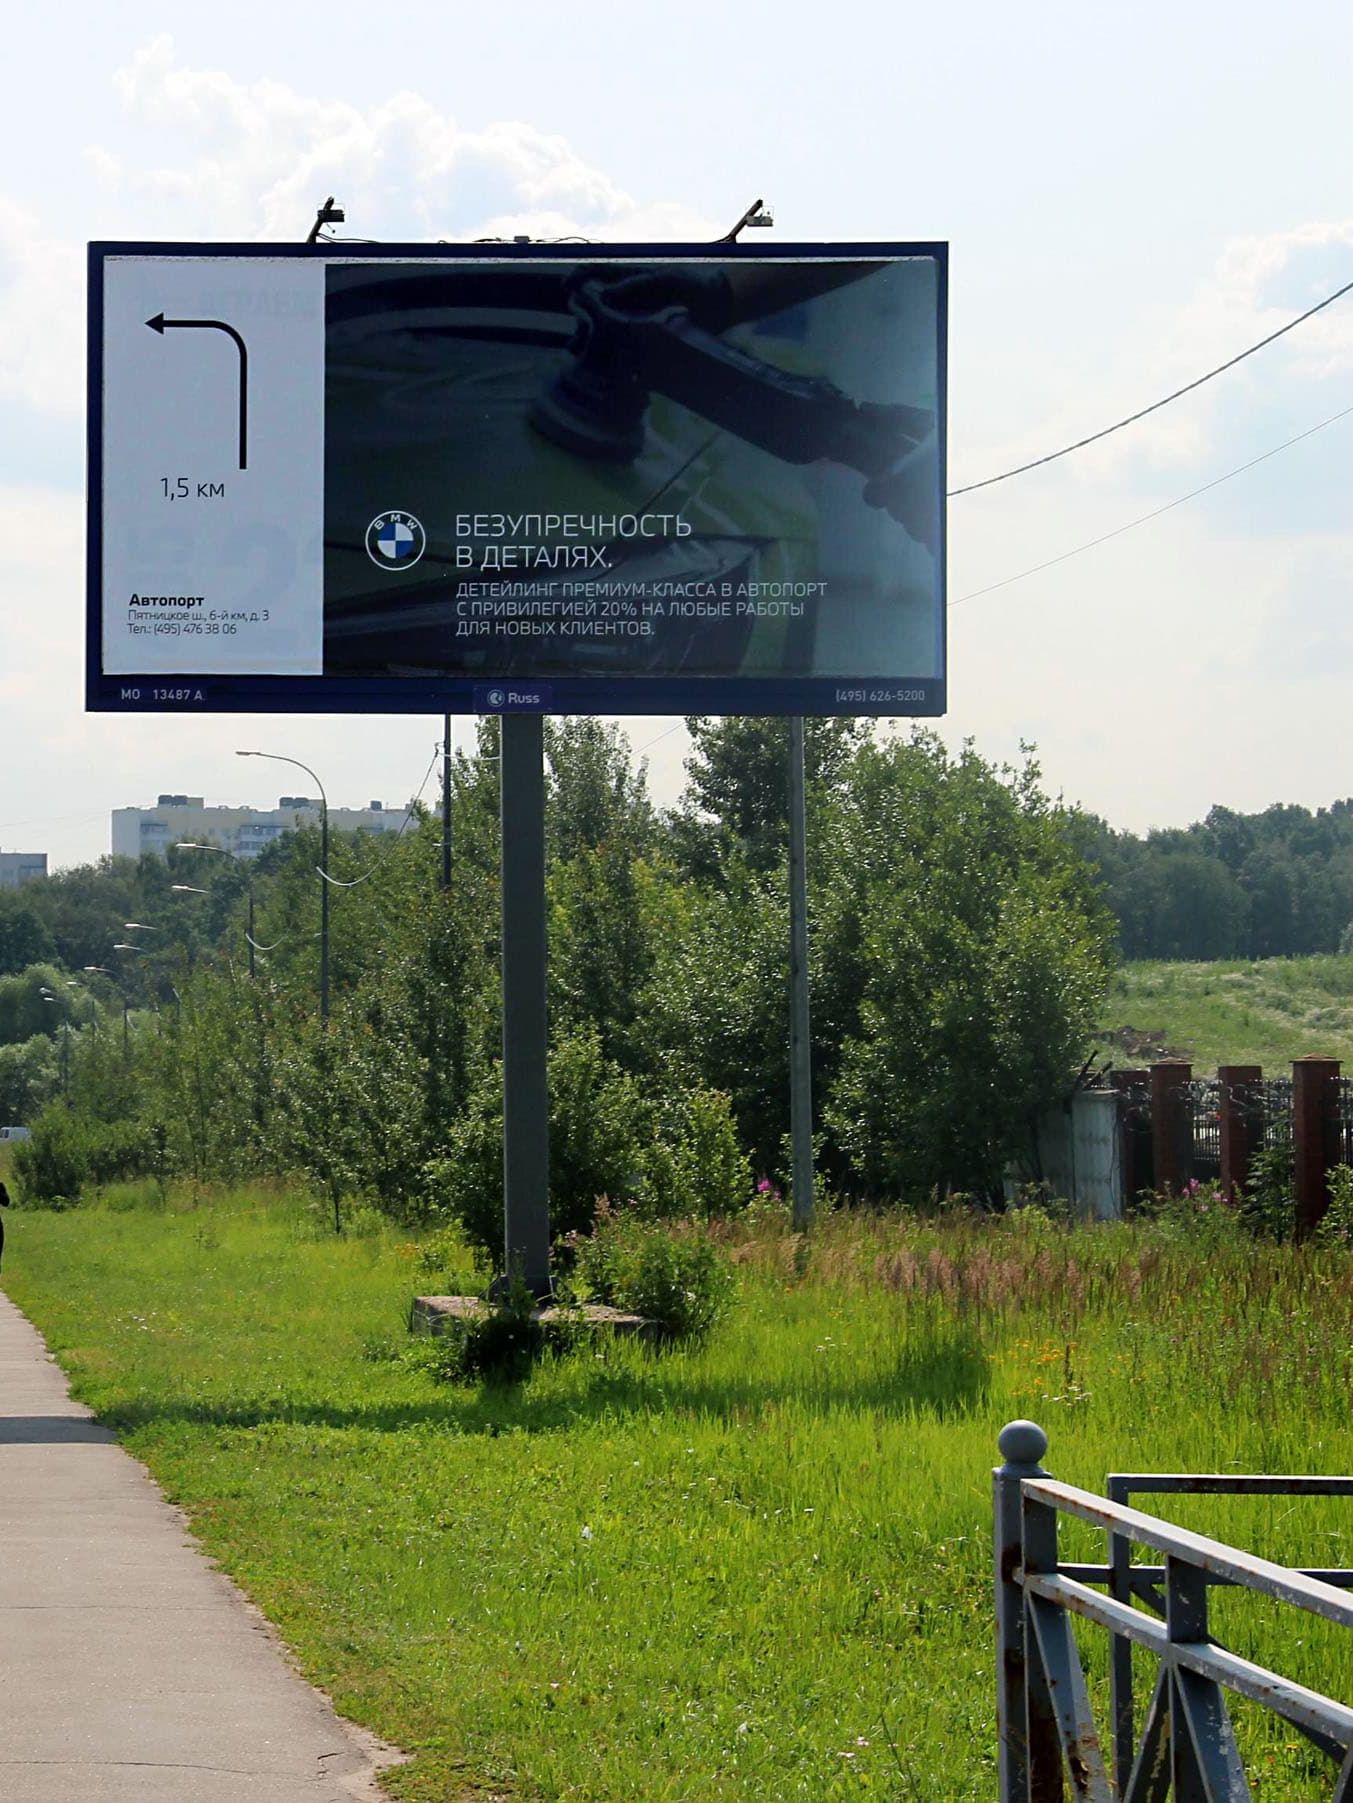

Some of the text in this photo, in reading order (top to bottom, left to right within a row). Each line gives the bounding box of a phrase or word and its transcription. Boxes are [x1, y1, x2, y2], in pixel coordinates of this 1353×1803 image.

[160, 477, 225, 500] 1,5 км
[374, 514, 418, 530] BMW
[456, 514, 692, 537] БЕЗУПРЕЧНОСТЬ
[456, 546, 613, 571] В ДЕТАЛЯХ.
[456, 581, 827, 598] ДЕТЕЙЛИНГ ПРЕМИУМ-КЛАССА В АВТОПОРТ
[129, 593, 205, 608] Автопорт
[128, 610, 189, 621] Пятницкое
[209, 609, 230, 621] 6-й
[231, 612, 248, 622] км,
[250, 612, 260, 622] д.
[262, 610, 270, 621] 3
[456, 600, 804, 617] С ПРИВИЛЕГИЕЙ 20% НА ЛЮБЫЕ РАБОТЫ
[128, 623, 237, 636] Тел.: (495) 476 38 06
[456, 621, 655, 636] ДЛЯ НОВЫХ КЛИЕНТОВ.
[153, 689, 191, 700] 13487
[508, 692, 540, 704] Russ
[835, 689, 925, 702] (495) 626-5200
